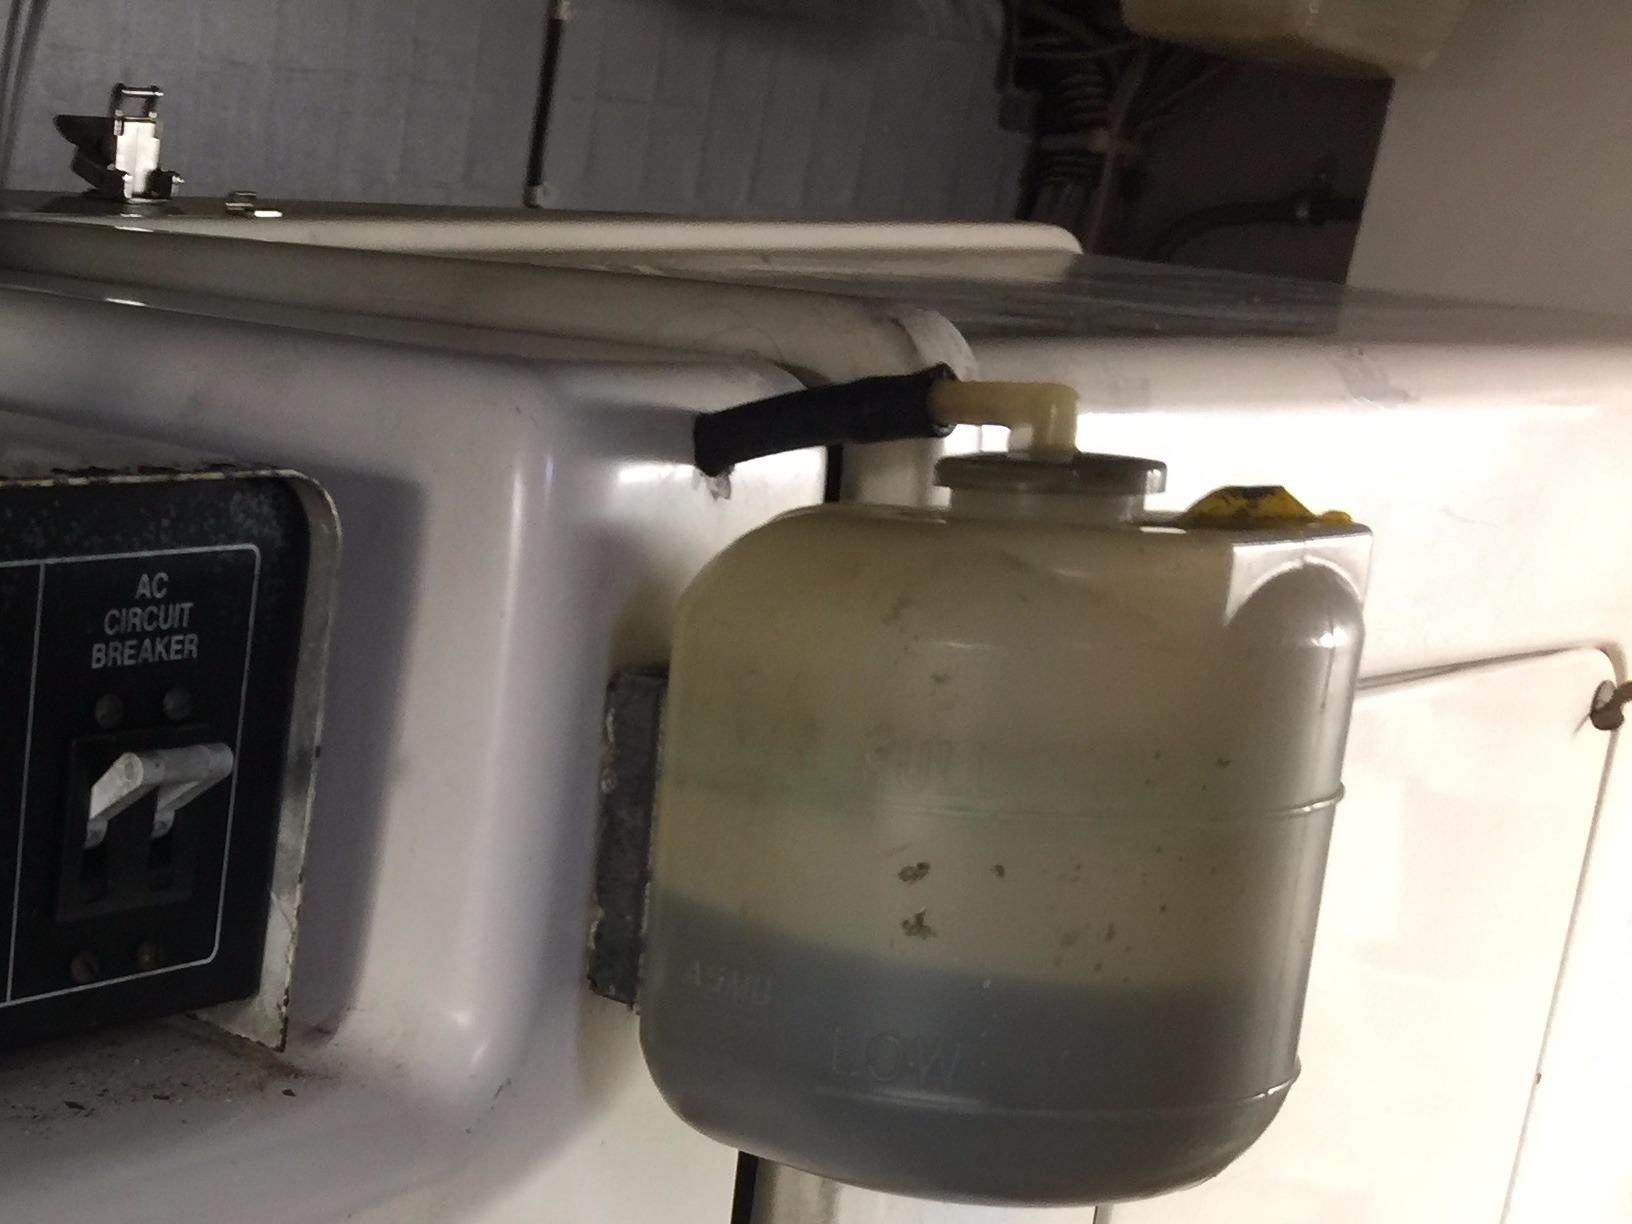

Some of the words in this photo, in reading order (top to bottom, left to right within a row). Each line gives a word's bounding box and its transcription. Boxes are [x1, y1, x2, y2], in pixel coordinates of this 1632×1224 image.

[135, 572, 169, 600] AC
[103, 602, 194, 636] CIRCUIT
[90, 633, 199, 670] BREAKER
